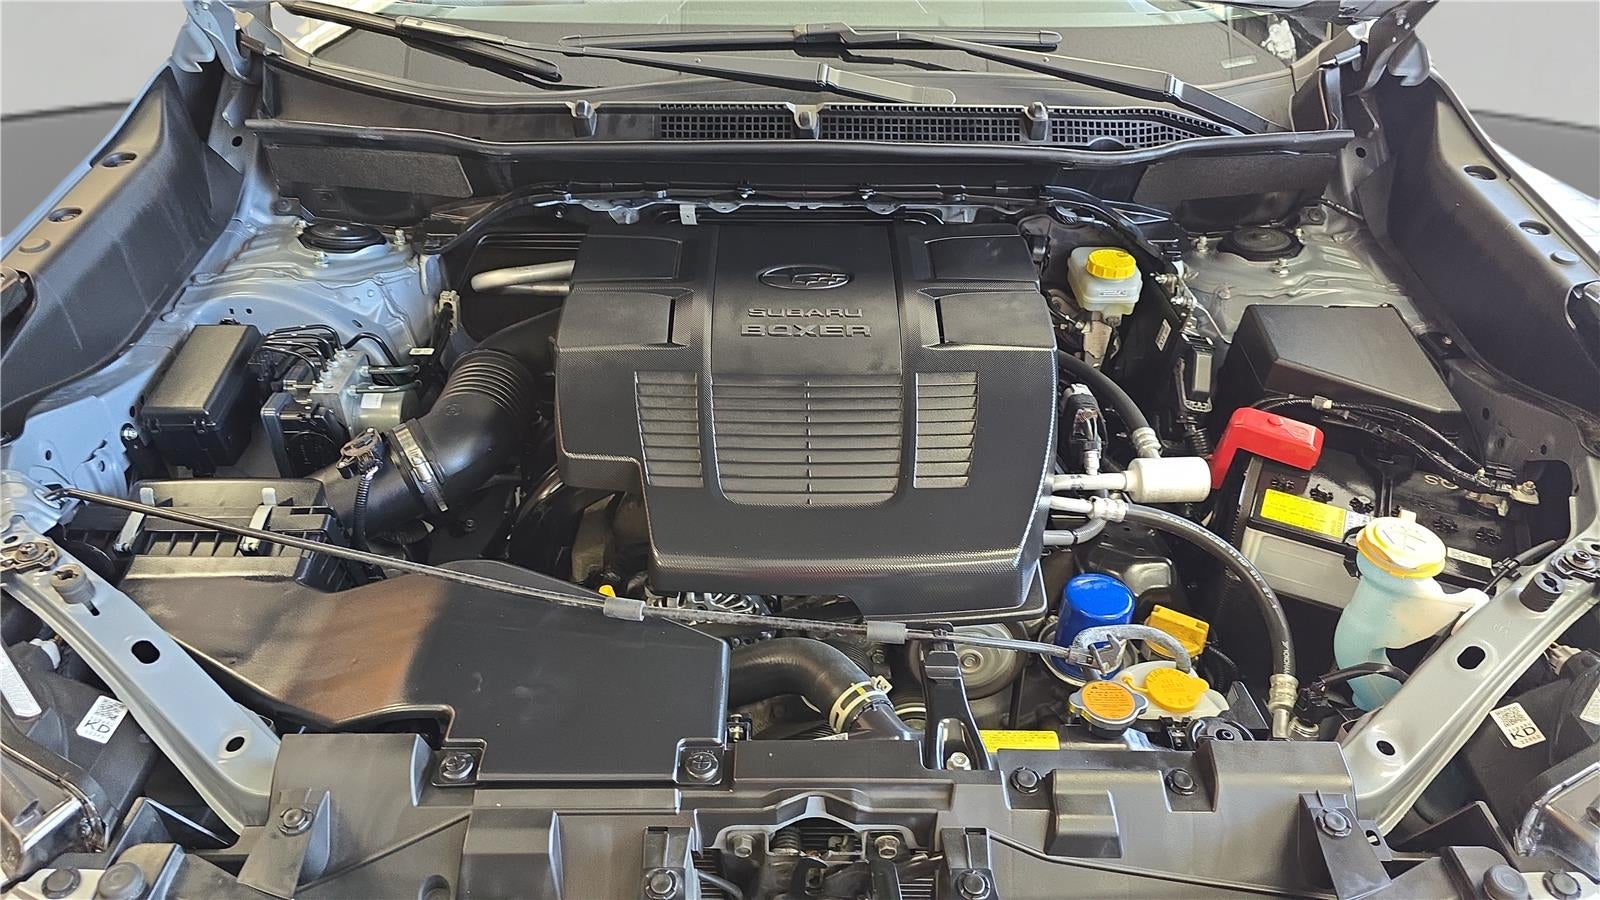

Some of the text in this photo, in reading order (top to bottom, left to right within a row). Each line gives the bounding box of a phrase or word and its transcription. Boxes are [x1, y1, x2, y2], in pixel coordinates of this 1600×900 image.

[748, 307, 863, 318] SUBARU
[740, 323, 872, 337] BOXER
[84, 719, 111, 733] KD
[1510, 726, 1536, 740] KD
